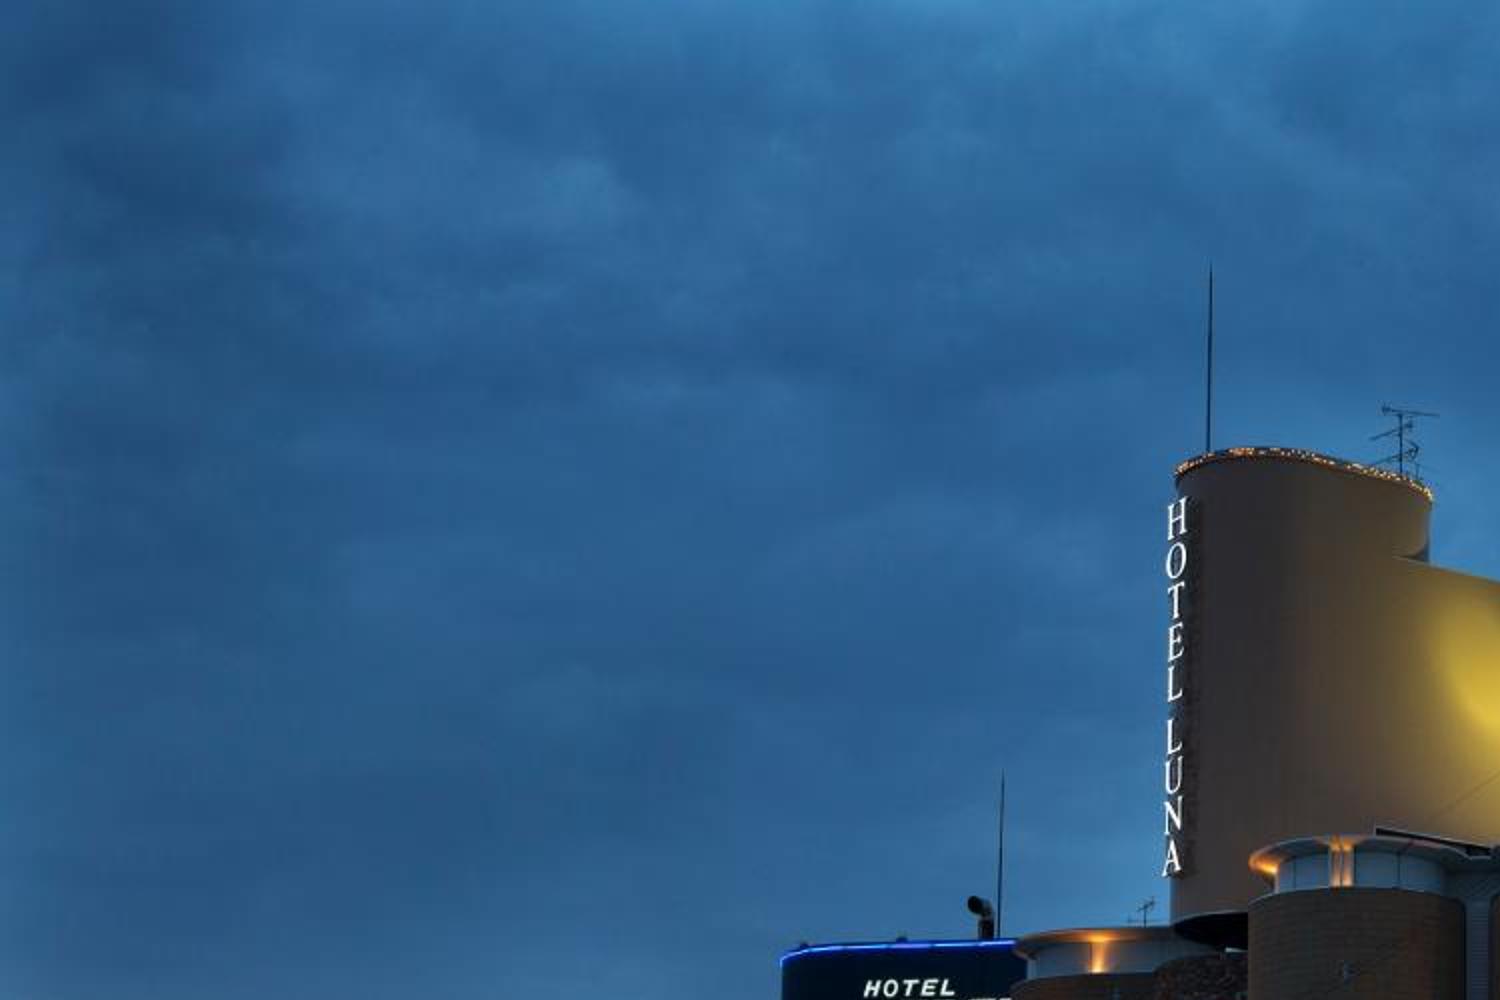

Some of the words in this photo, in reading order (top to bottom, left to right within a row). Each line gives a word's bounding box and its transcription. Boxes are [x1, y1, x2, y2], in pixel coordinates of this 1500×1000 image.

[1166, 495, 1187, 702] HOTEL
[1161, 717, 1184, 877] LUNA
[863, 979, 956, 998] HOTEL
